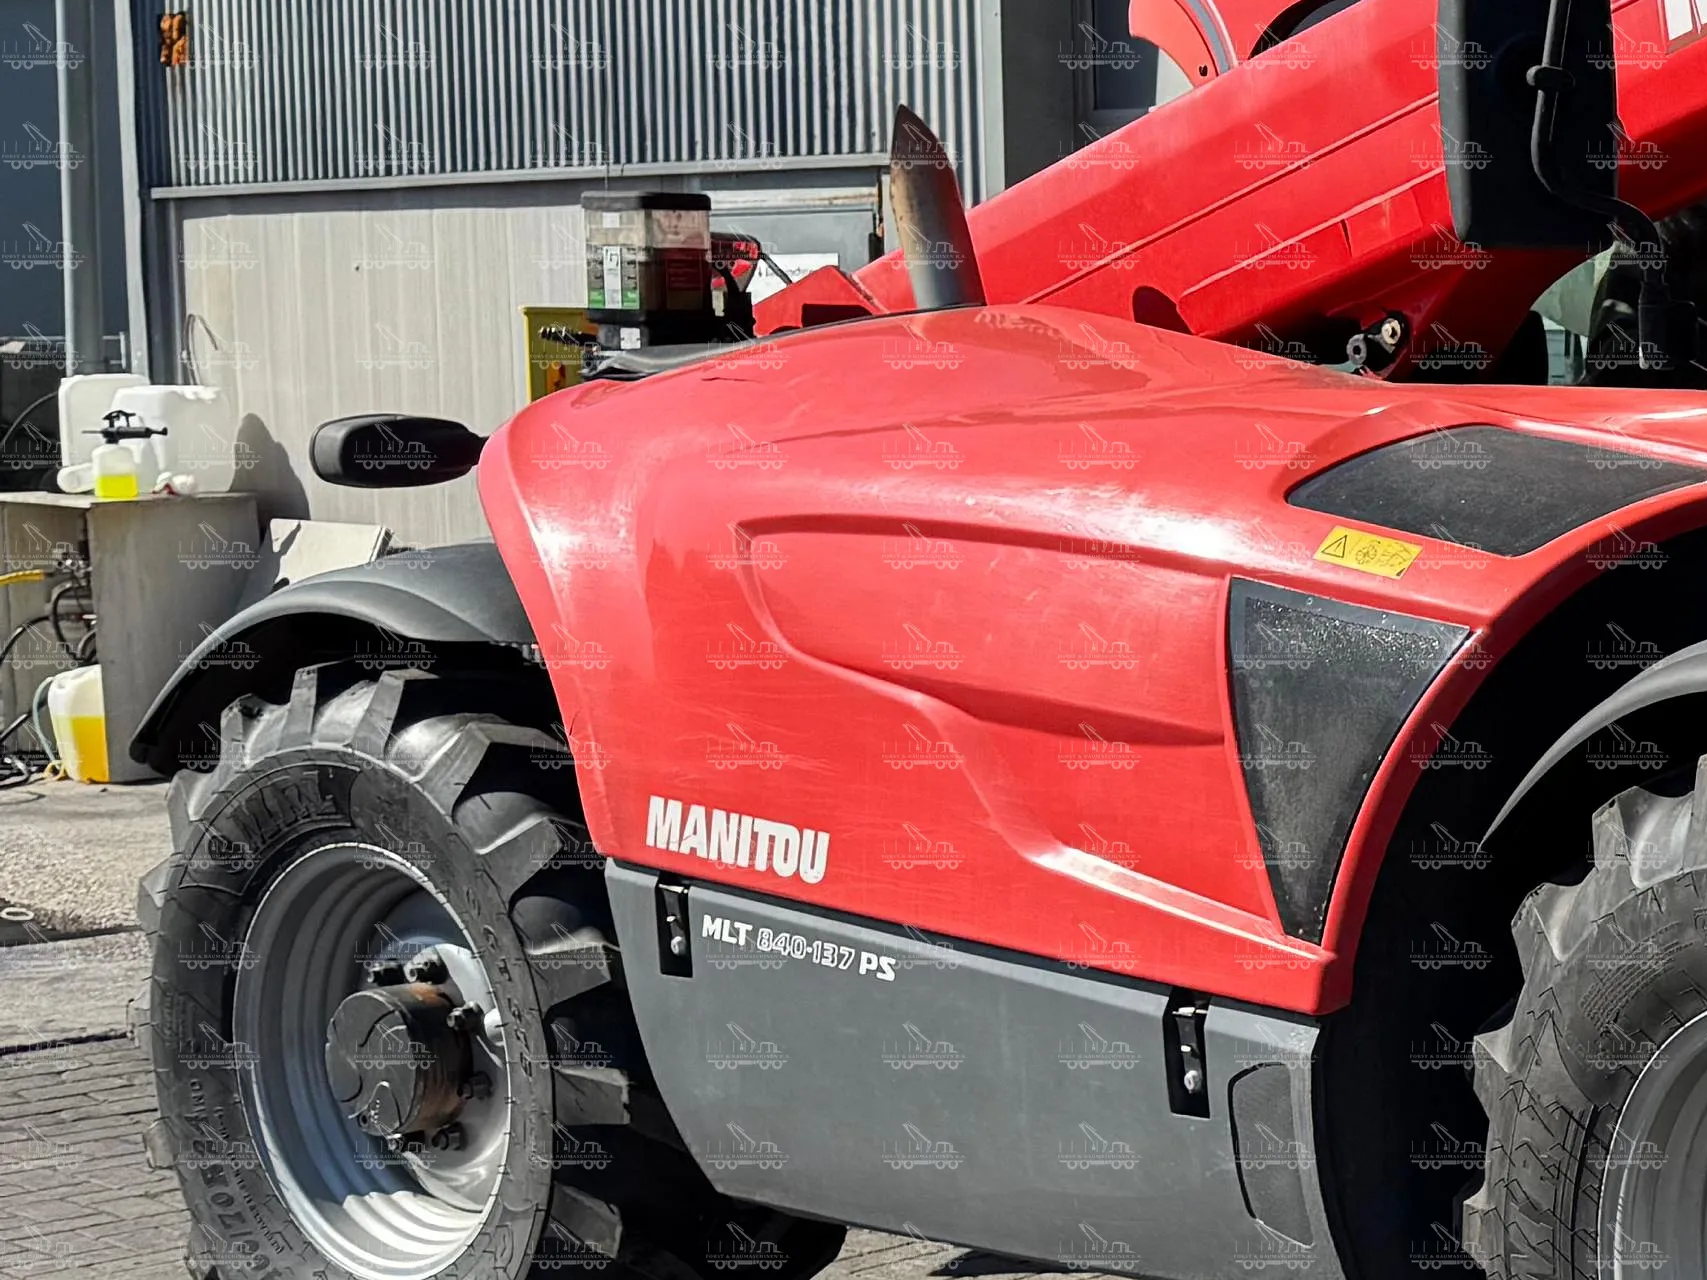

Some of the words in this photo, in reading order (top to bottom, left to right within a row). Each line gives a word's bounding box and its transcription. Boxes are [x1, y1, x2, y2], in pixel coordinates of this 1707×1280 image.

[646, 794, 830, 885] MANITOU
[701, 914, 753, 946] MLT
[858, 951, 897, 982] PS
